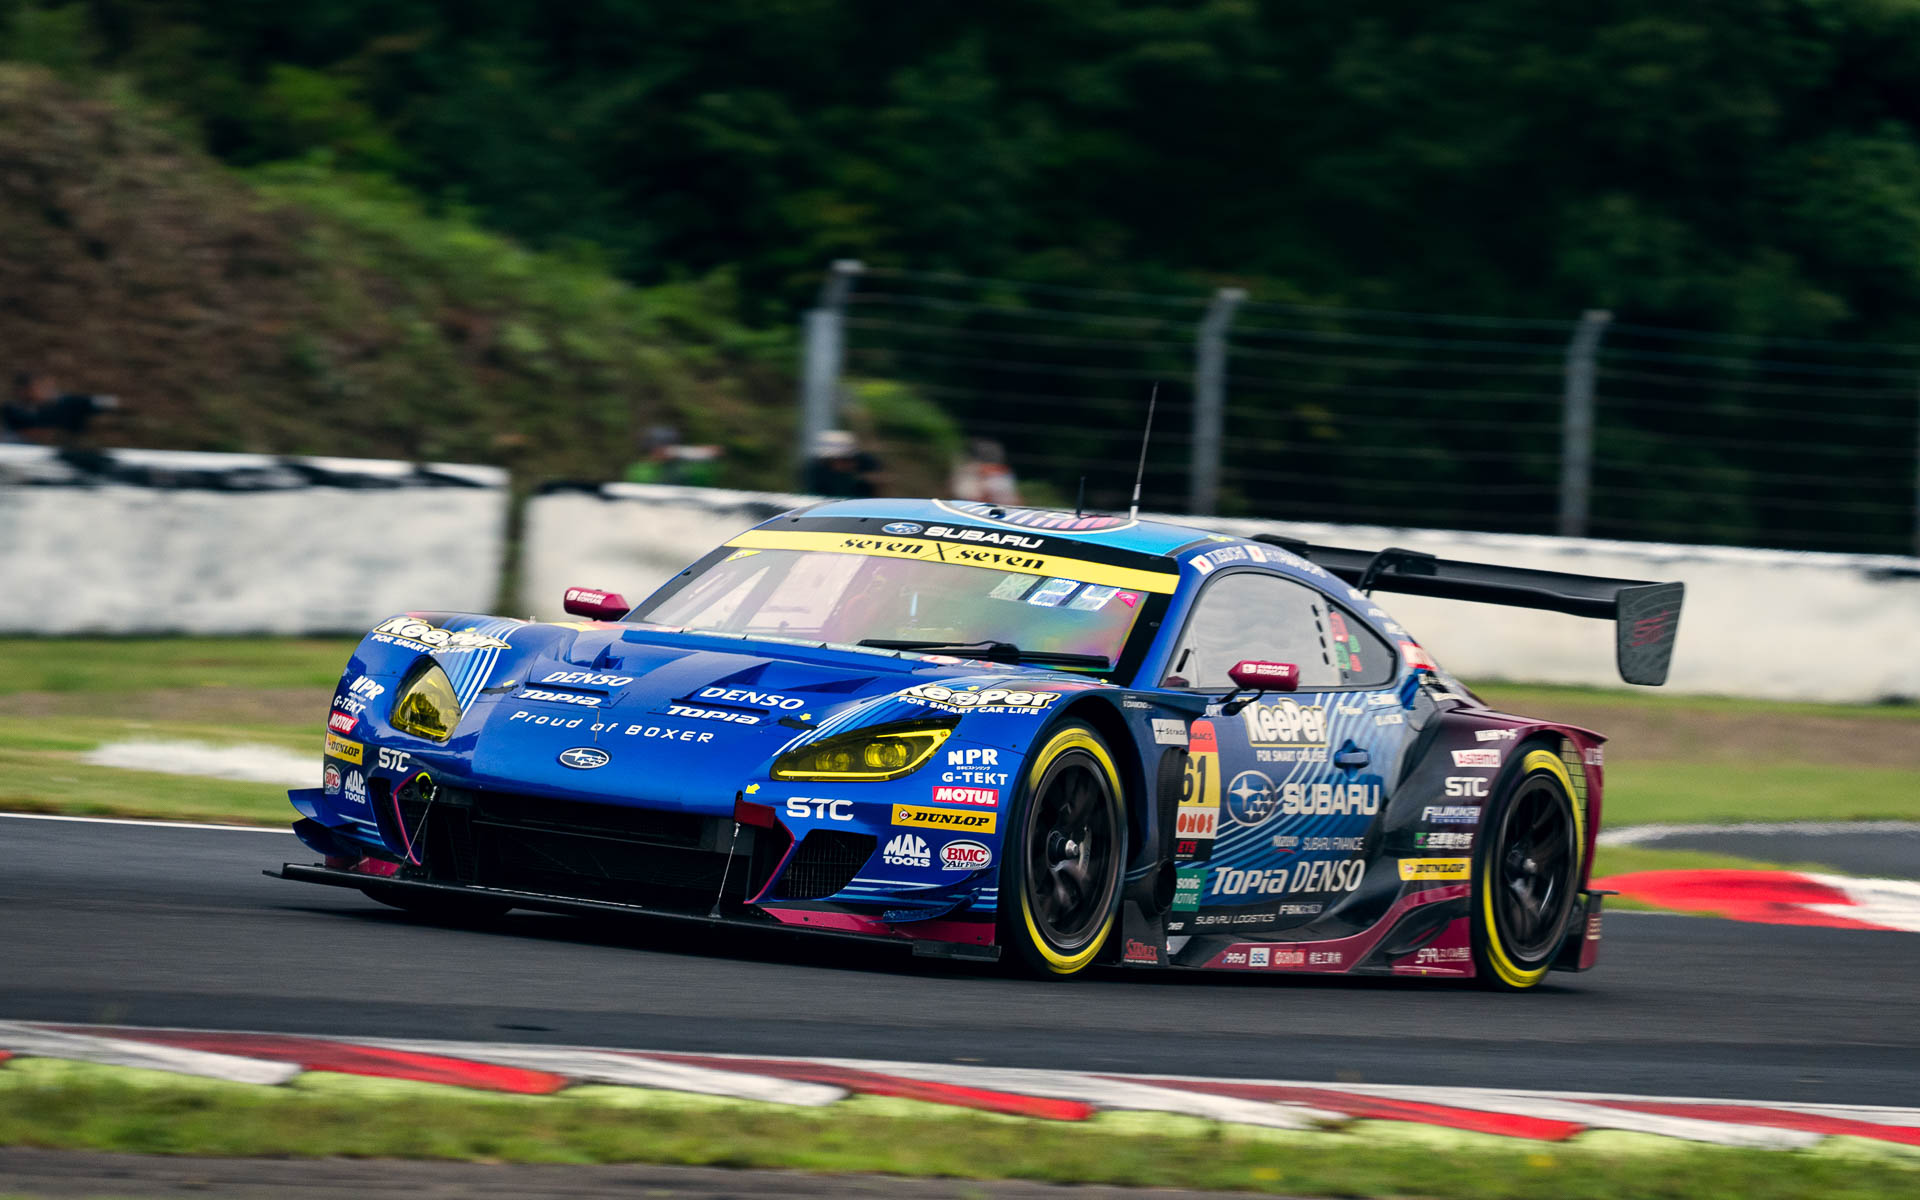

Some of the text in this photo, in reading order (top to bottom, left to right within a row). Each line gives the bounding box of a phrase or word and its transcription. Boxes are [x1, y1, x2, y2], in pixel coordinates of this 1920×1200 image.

[924, 526, 1044, 549] SUBARU
[840, 538, 924, 555] seven
[956, 549, 1045, 570] seven
[371, 633, 394, 645] FOR
[393, 638, 430, 653] SMART
[376, 617, 510, 649] KeePer
[349, 675, 385, 701] NPR
[541, 671, 634, 687] DENSO
[333, 695, 366, 715] G-TEKT
[699, 687, 805, 710] DENSO
[893, 685, 1061, 709] KeePer
[898, 697, 1040, 716] FOR SMART CAR LIFE
[329, 713, 355, 731] MOTUL
[509, 711, 715, 744] Proud of BOXER
[1241, 698, 1328, 743] KeePer
[331, 742, 360, 758] DUNLOP
[378, 746, 411, 773] STC
[947, 748, 999, 766] NPR
[344, 770, 366, 796] MAC
[941, 771, 1008, 786] G-TEKT
[1180, 755, 1207, 804] 61
[1444, 776, 1490, 797] STC
[344, 791, 366, 805] TOOLS
[935, 788, 996, 805] MOTUL
[1282, 783, 1380, 815] SUBARU
[786, 796, 854, 821] STC
[913, 812, 990, 827] DUNLOP
[883, 834, 931, 858] MAC
[946, 847, 986, 863] BMC
[883, 855, 931, 868] TOOLS
[946, 860, 965, 868] Air
[1288, 859, 1366, 893] DENSO
[1195, 915, 1232, 925] SUBARU
